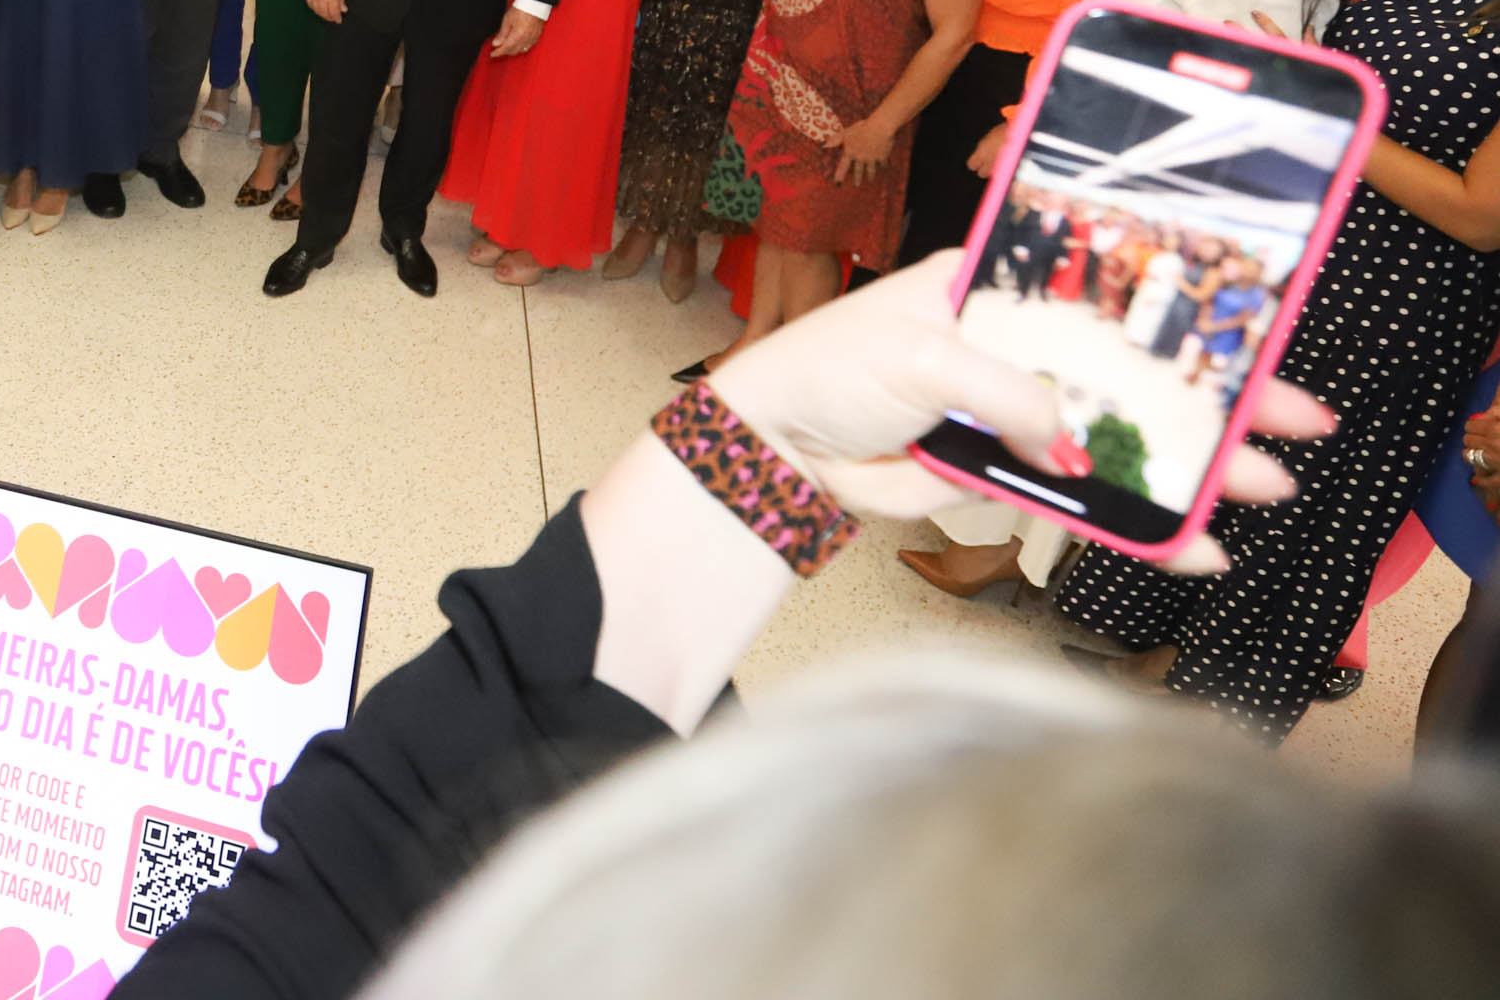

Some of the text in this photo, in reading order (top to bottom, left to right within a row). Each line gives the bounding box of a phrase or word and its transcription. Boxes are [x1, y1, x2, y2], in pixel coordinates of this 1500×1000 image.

[20, 695, 74, 750] DIA
[83, 702, 105, 757] É
[110, 720, 155, 772] DE
[26, 771, 73, 805] CODE
[75, 784, 86, 809] E
[15, 802, 106, 851] MOMENTO
[26, 842, 38, 867] O
[42, 847, 102, 886] NOSSO
